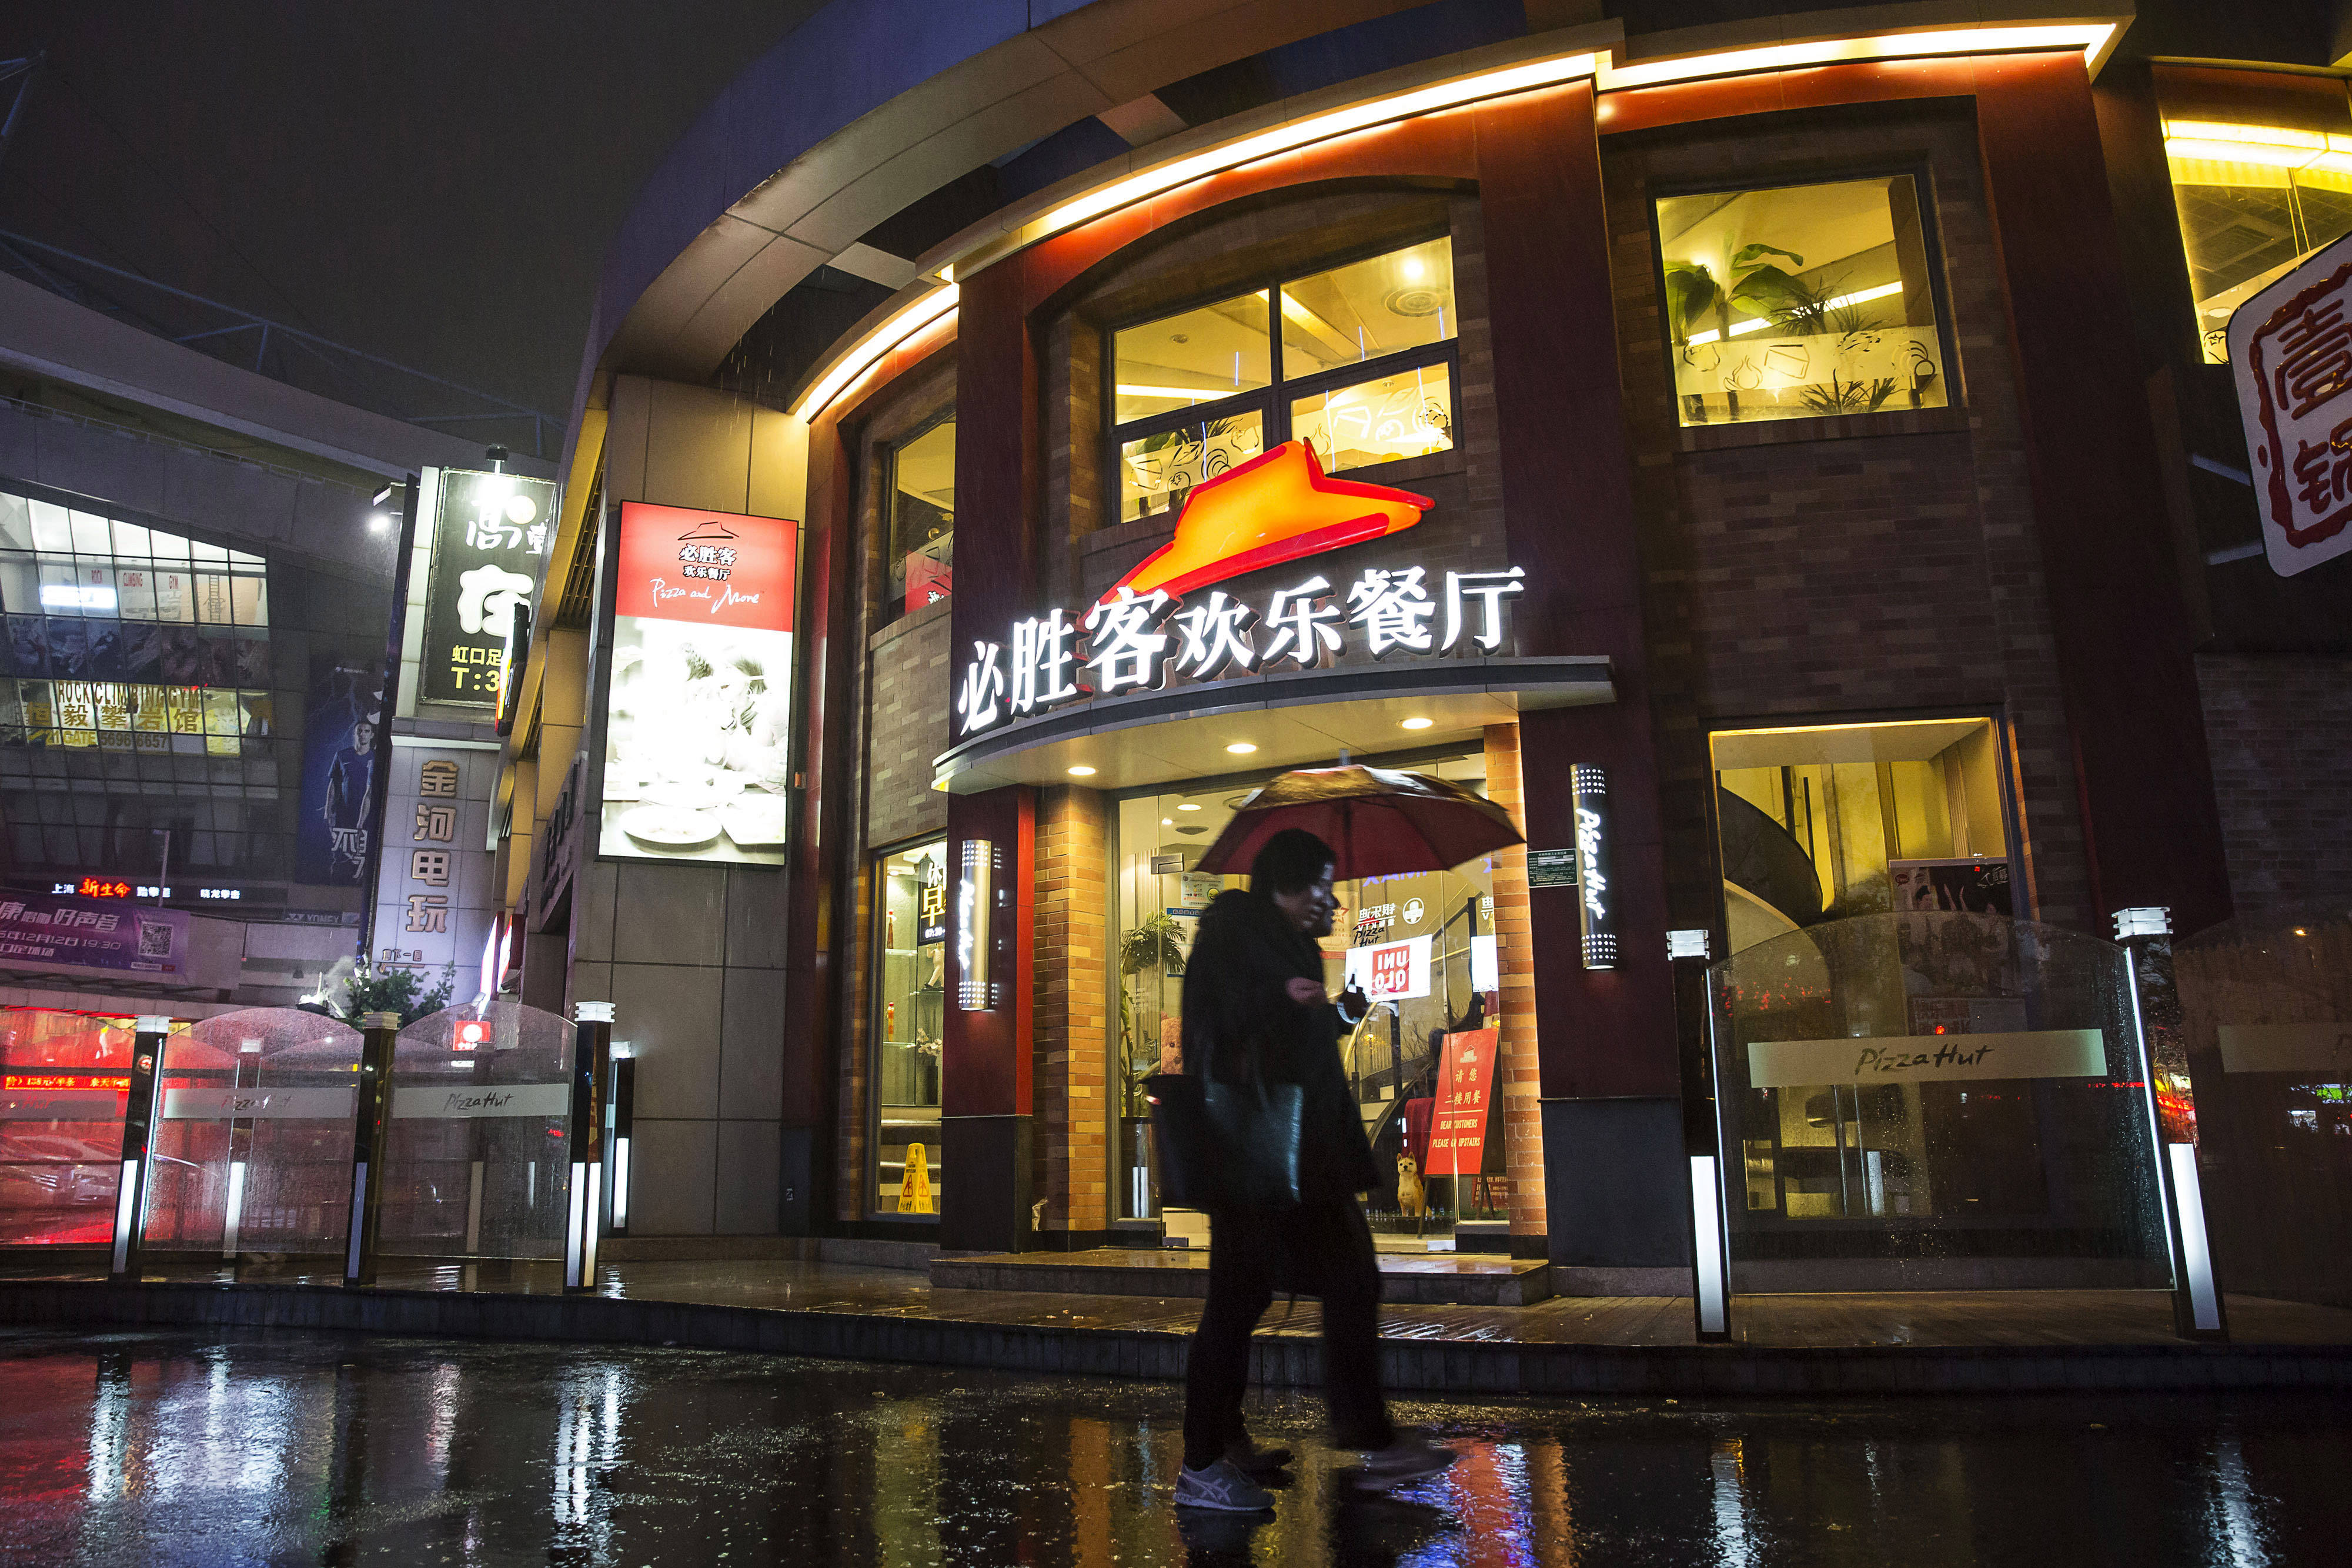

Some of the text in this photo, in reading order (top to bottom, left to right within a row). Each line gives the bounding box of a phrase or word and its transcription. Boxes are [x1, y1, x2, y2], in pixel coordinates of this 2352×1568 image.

[679, 543, 737, 566] 必胜客
[682, 564, 731, 581] 欢乐餐厅
[650, 577, 759, 614] Pizza and More
[958, 566, 1526, 737] 必胜客欢乐餐厅
[58, 681, 90, 704] ROCK
[406, 760, 459, 933] 金河电玩
[52, 884, 75, 894] 上海
[79, 878, 131, 897] 新生命
[920, 884, 947, 927] 早
[1354, 925, 1385, 945] Pizza
[1444, 1090, 1481, 1106] 二楼用餐
[1440, 1119, 1478, 1129] DEAR CUSTOMERS
[1432, 1138, 1448, 1148] PLEASE
[1458, 1137, 1481, 1146] UPSTAIRS
